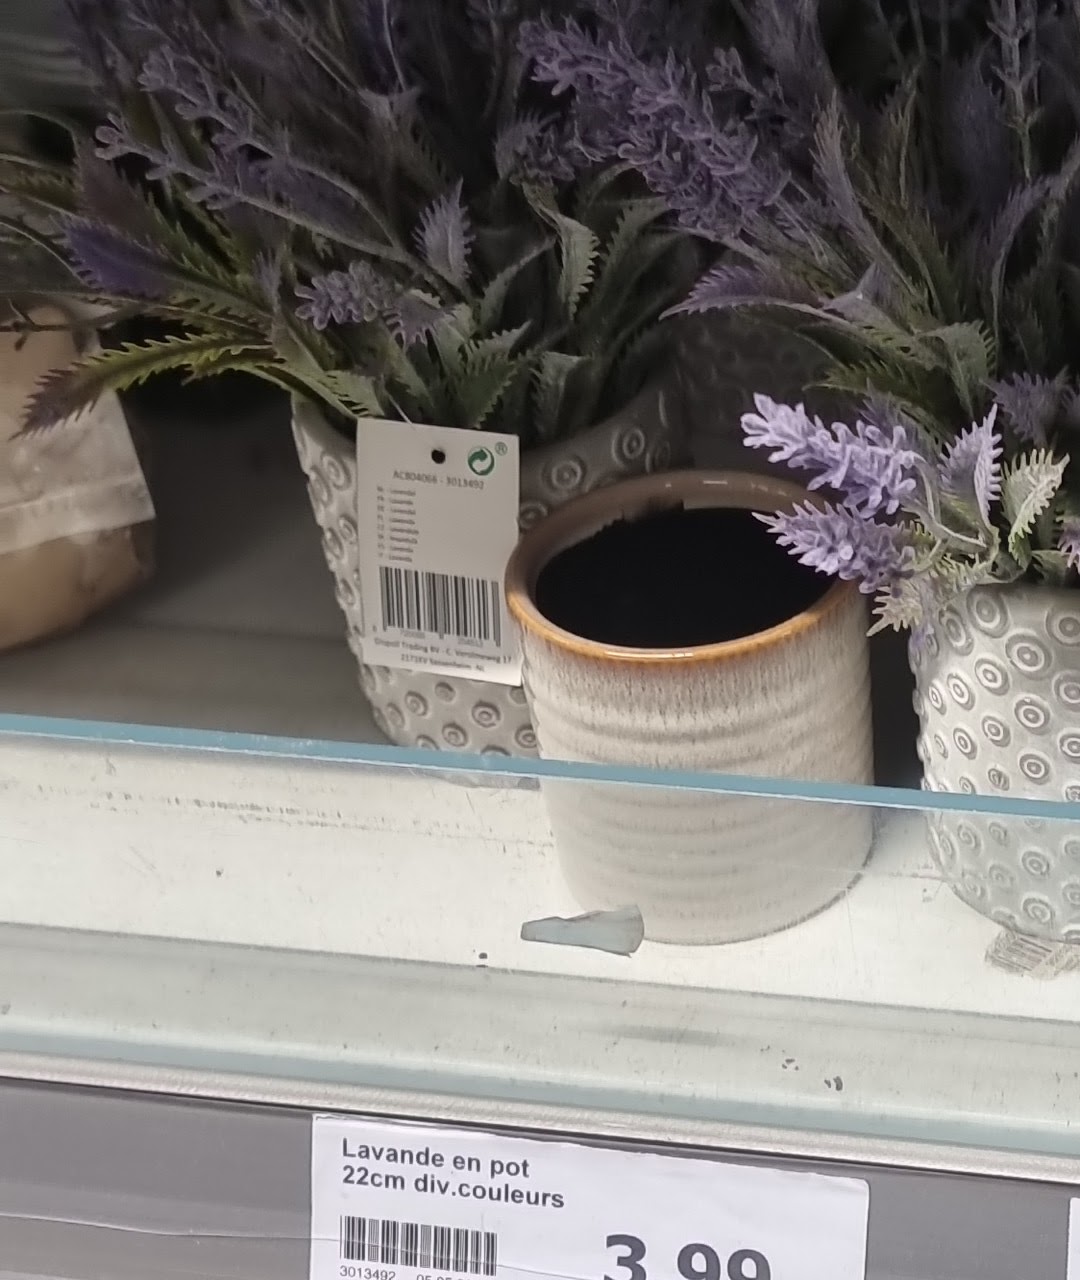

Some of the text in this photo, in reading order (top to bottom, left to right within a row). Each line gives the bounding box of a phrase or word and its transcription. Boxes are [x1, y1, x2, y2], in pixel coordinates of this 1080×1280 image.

[343, 1138, 529, 1179] Lavande en pot
[343, 1165, 564, 1208] 22cm div.couleurs
